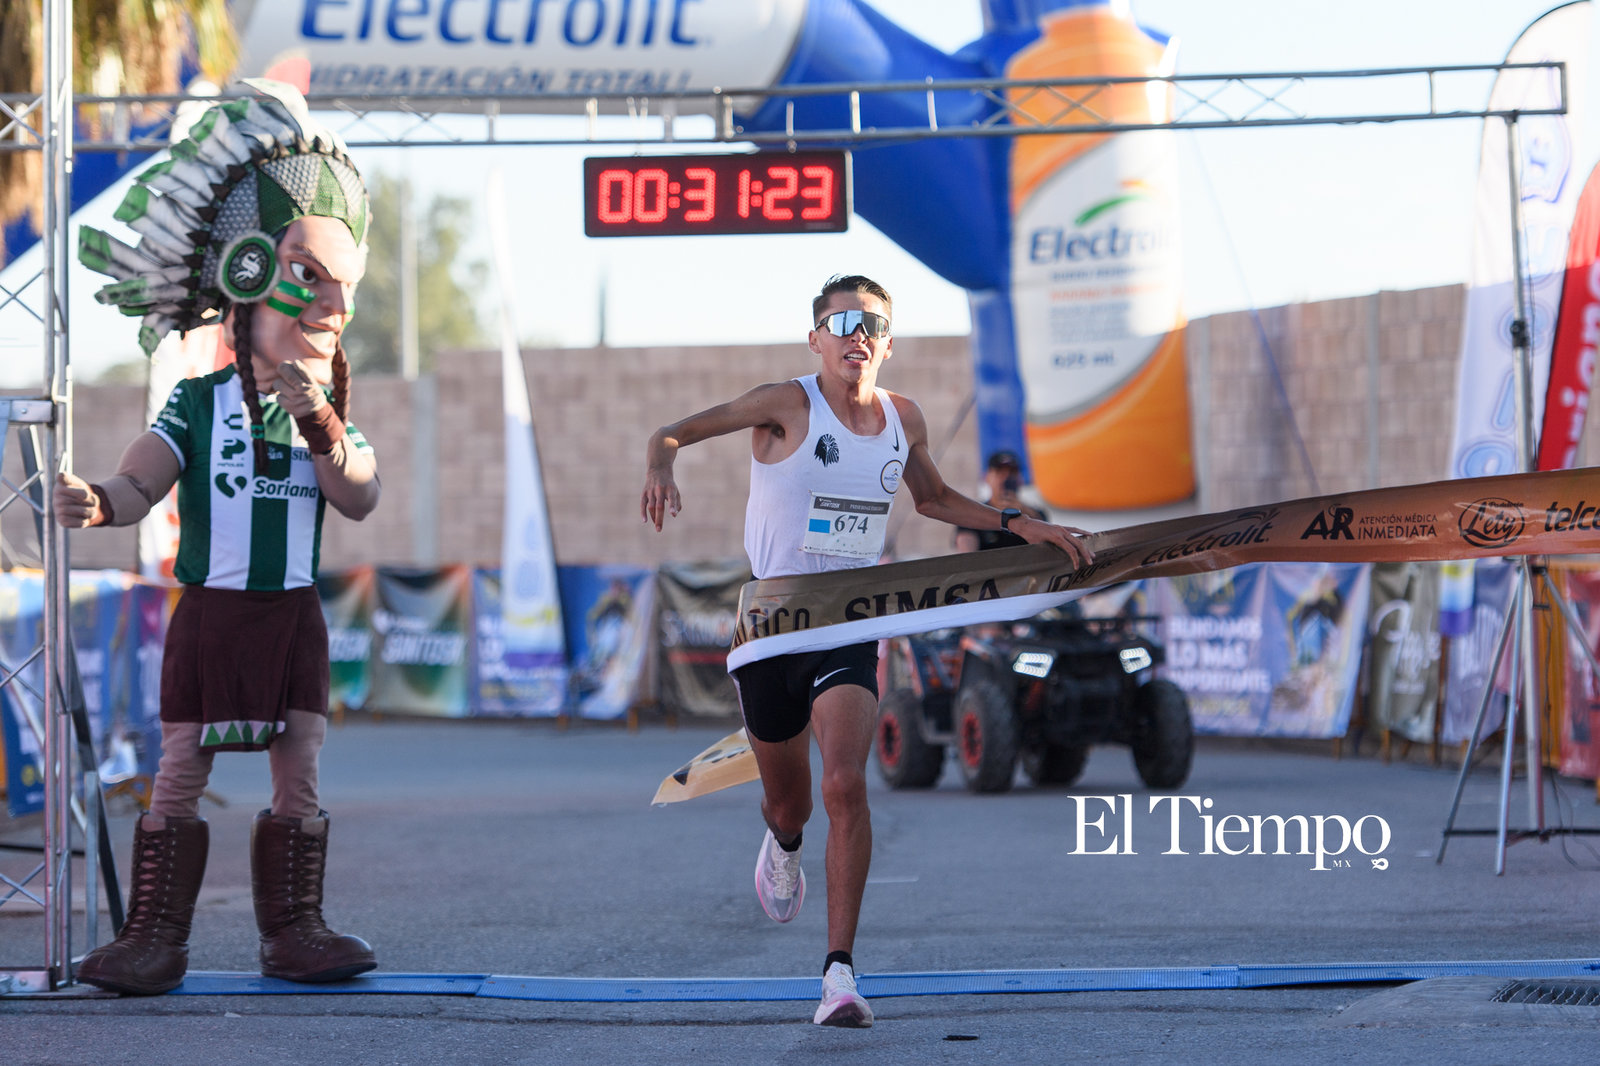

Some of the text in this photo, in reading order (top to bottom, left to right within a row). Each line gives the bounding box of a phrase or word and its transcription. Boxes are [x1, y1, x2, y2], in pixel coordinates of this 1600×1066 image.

[253, 479, 318, 498] Soriana
[834, 514, 869, 534] 674
[1360, 511, 1438, 525] ATENCIÓN MÉDICA
[1358, 525, 1438, 539] INMEDIATA
